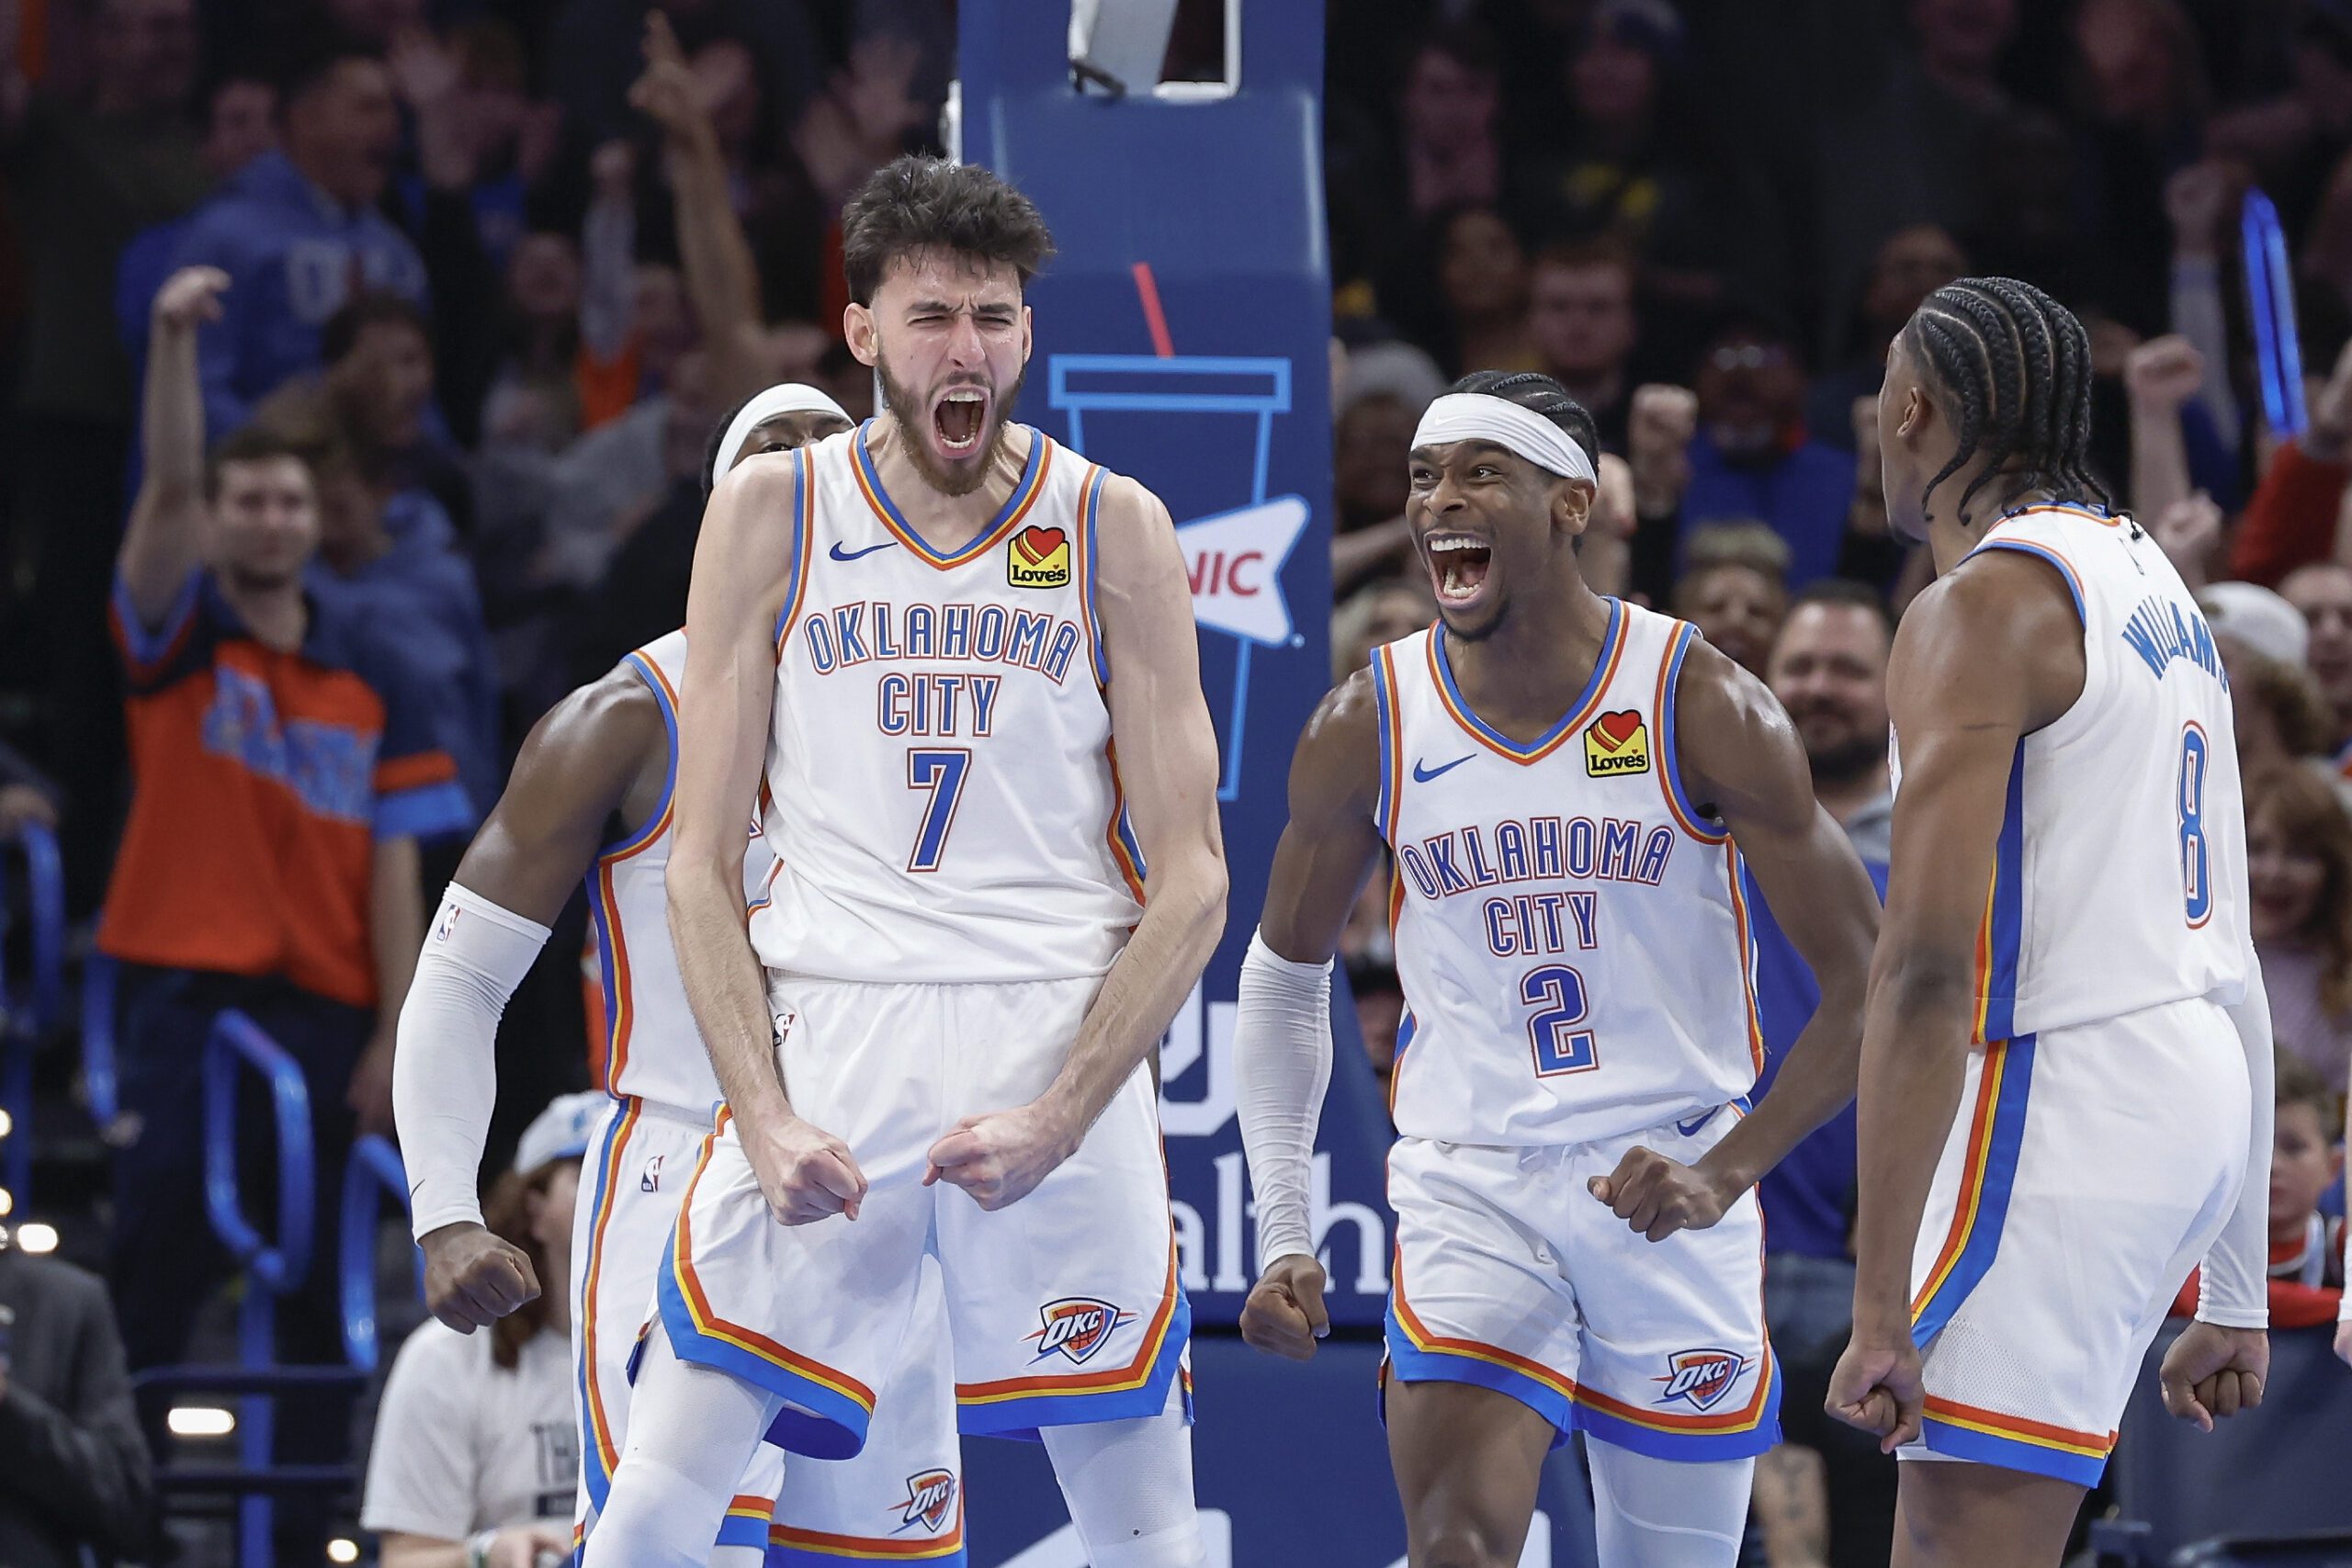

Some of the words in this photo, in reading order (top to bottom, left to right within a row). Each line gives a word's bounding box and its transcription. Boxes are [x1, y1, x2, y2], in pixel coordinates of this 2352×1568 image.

[1188, 551, 1264, 596] NIC
[804, 601, 1080, 686] OKLAHOMA
[877, 672, 1001, 737] CITY
[907, 747, 972, 874] 7
[2177, 719, 2213, 931] 8
[1400, 817, 1675, 900] OKLAHOMA
[1483, 891, 1598, 957] CITY
[1520, 964, 1600, 1079] 2
[1038, 1309, 1102, 1354] OKC
[1664, 1359, 1729, 1397] OKC
[903, 1479, 950, 1523] OKC
